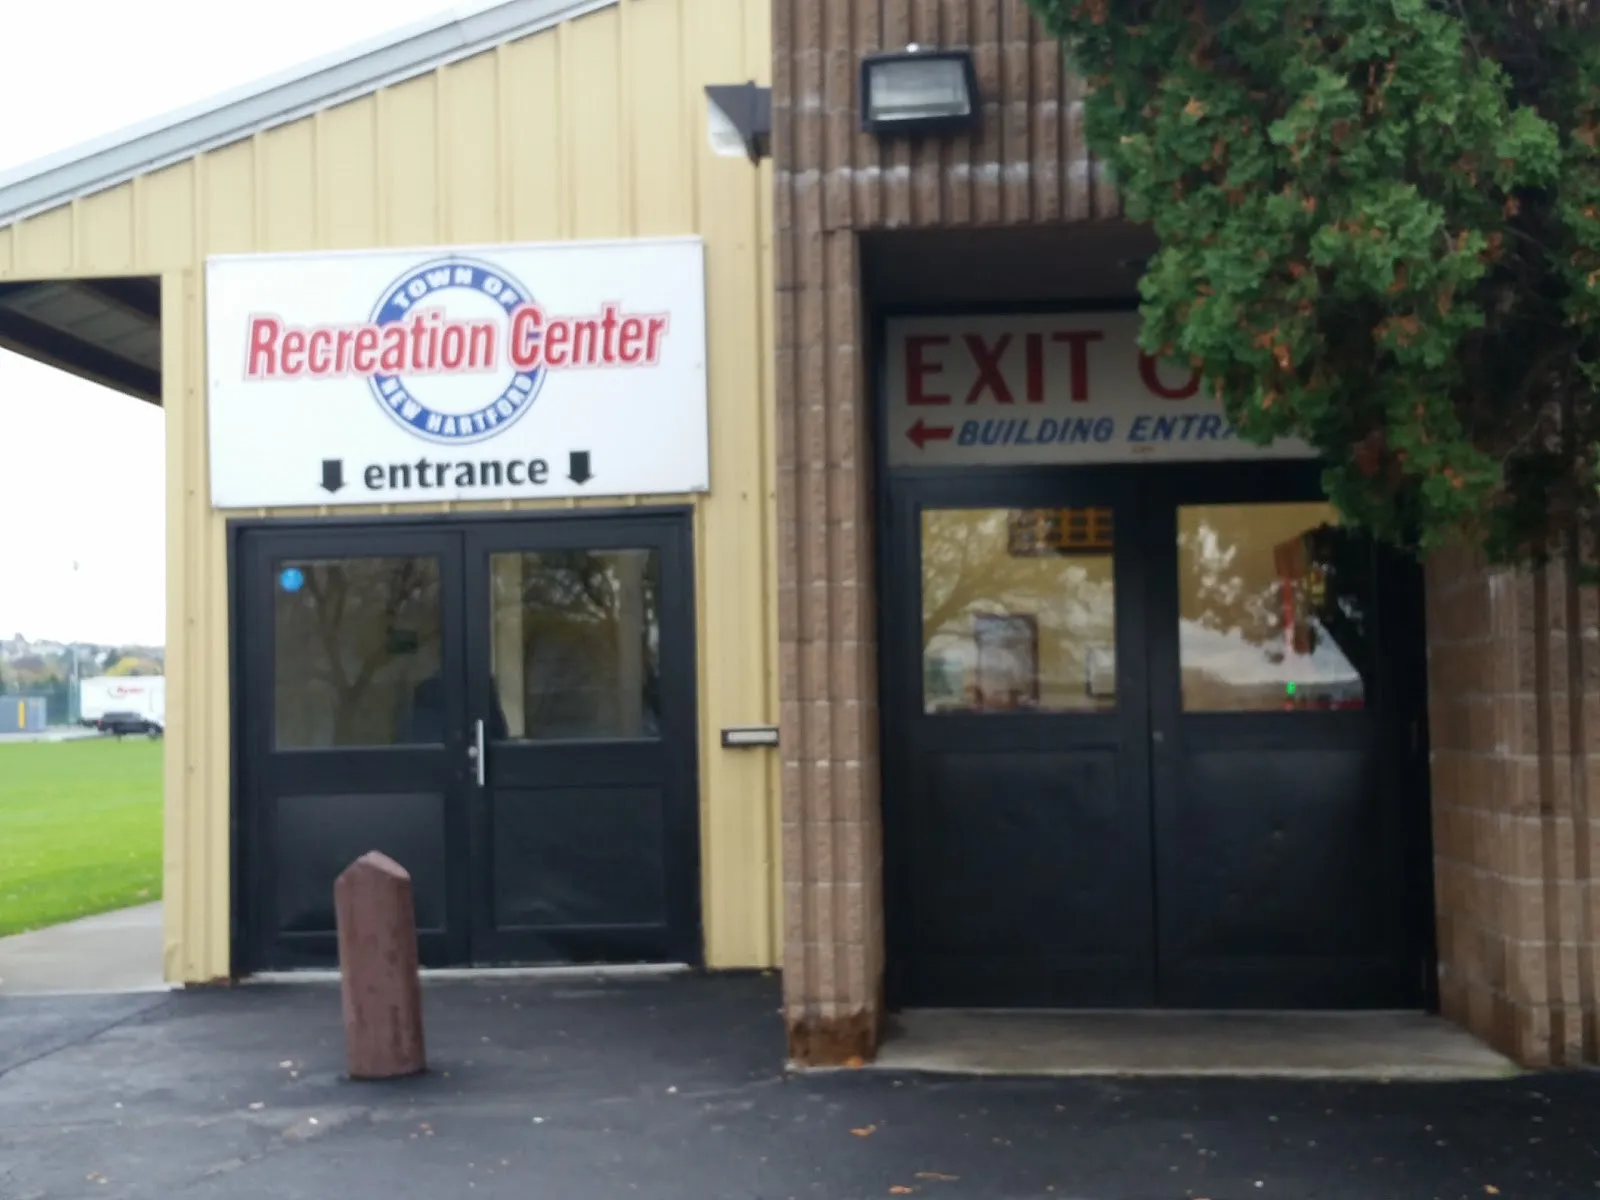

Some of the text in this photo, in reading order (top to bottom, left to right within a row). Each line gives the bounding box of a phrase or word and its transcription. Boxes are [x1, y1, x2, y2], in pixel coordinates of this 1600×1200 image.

[391, 267, 521, 309] TOWN OF
[247, 305, 667, 376] Recreation Center
[904, 330, 1104, 406] EXIT
[380, 373, 533, 436] NEW HARTFORD
[956, 414, 1114, 447] BUILDING
[363, 456, 549, 490] entrance
